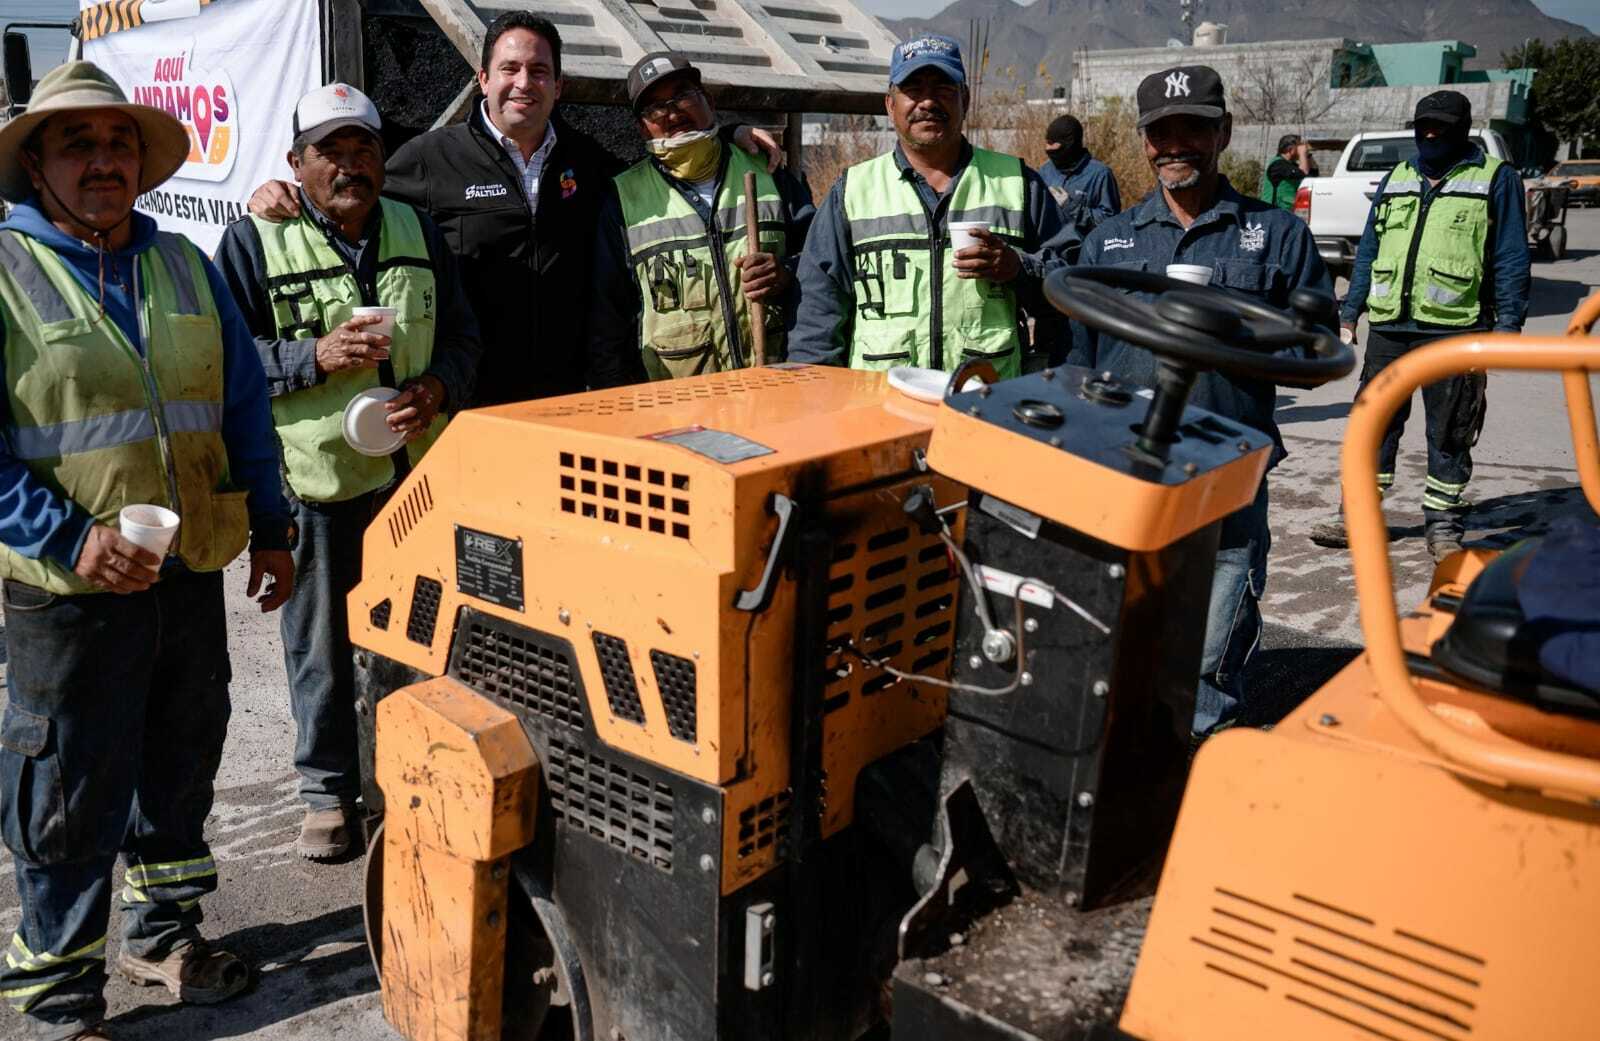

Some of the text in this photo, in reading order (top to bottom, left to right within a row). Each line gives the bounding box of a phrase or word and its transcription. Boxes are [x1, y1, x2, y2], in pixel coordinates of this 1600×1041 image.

[154, 51, 186, 83] AQUÍ
[1164, 71, 1191, 98] NY
[134, 85, 229, 122] ANDAMOS
[465, 184, 507, 200] SALTILLO
[174, 194, 208, 223] ESTA
